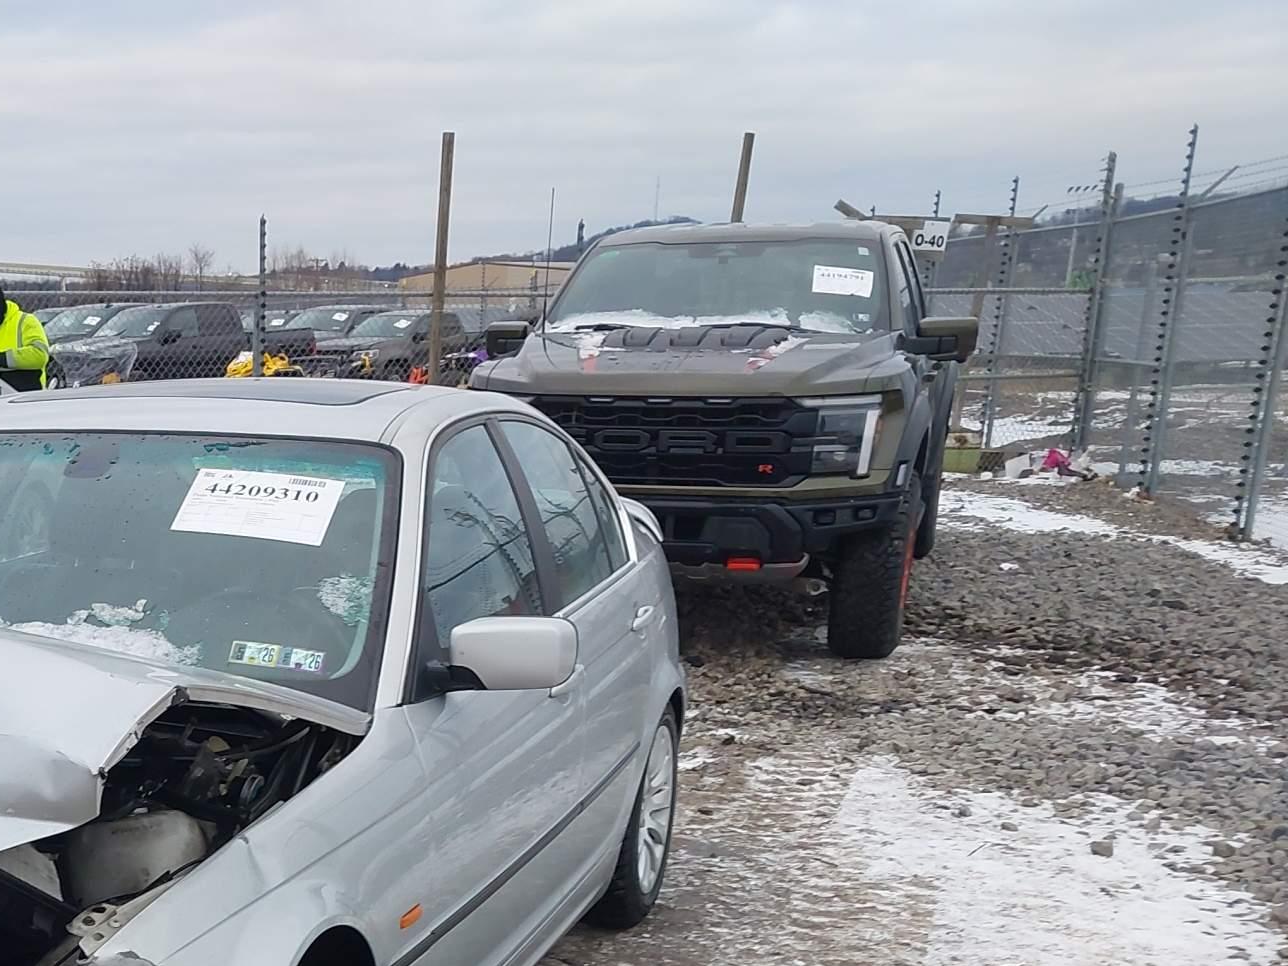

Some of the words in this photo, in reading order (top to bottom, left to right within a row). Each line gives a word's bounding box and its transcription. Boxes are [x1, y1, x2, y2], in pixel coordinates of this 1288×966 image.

[758, 463, 774, 474] R
[205, 482, 319, 503] 44209310
[261, 647, 275, 662] 26
[308, 653, 322, 670] 26
